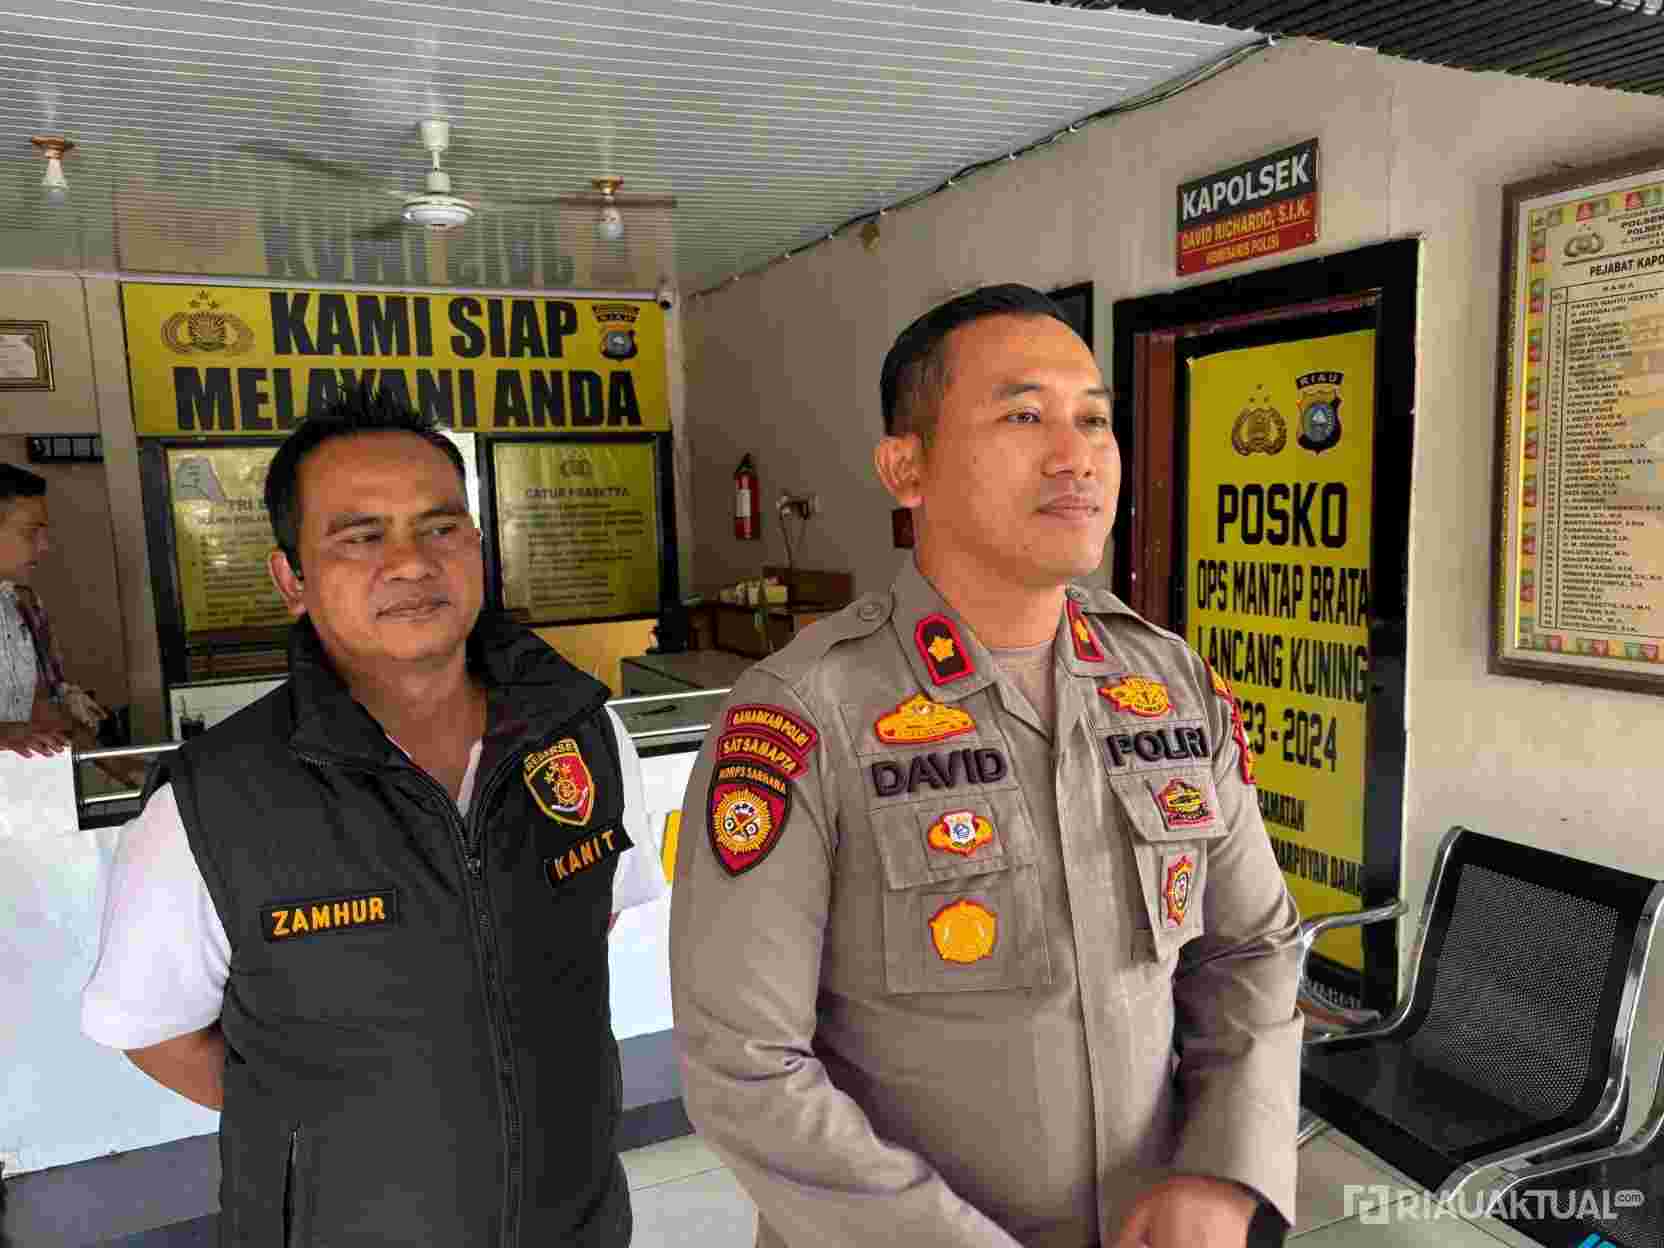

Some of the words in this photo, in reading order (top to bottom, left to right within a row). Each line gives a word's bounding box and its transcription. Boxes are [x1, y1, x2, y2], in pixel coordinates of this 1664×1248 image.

[1183, 151, 1310, 221] KAPOLSEK
[1590, 257, 1634, 277] PEJABAT
[268, 290, 433, 358] KAMI
[449, 296, 577, 359] SIAP
[173, 367, 478, 432] MELAYANI
[494, 368, 641, 428] ANDA
[1299, 372, 1339, 387] RIAU
[1217, 482, 1348, 548] POSKO
[1197, 559, 1227, 611] OPS
[1233, 561, 1303, 620] MANTAP
[1311, 566, 1369, 626] BRATA
[1290, 637, 1368, 704] KUNING
[1105, 726, 1209, 767] POLRI
[1235, 697, 1266, 755] 23
[1283, 708, 1336, 772] 2024
[871, 747, 1008, 798] DAVID
[553, 829, 616, 881] KANIT
[271, 896, 385, 937] ZAMHUR
